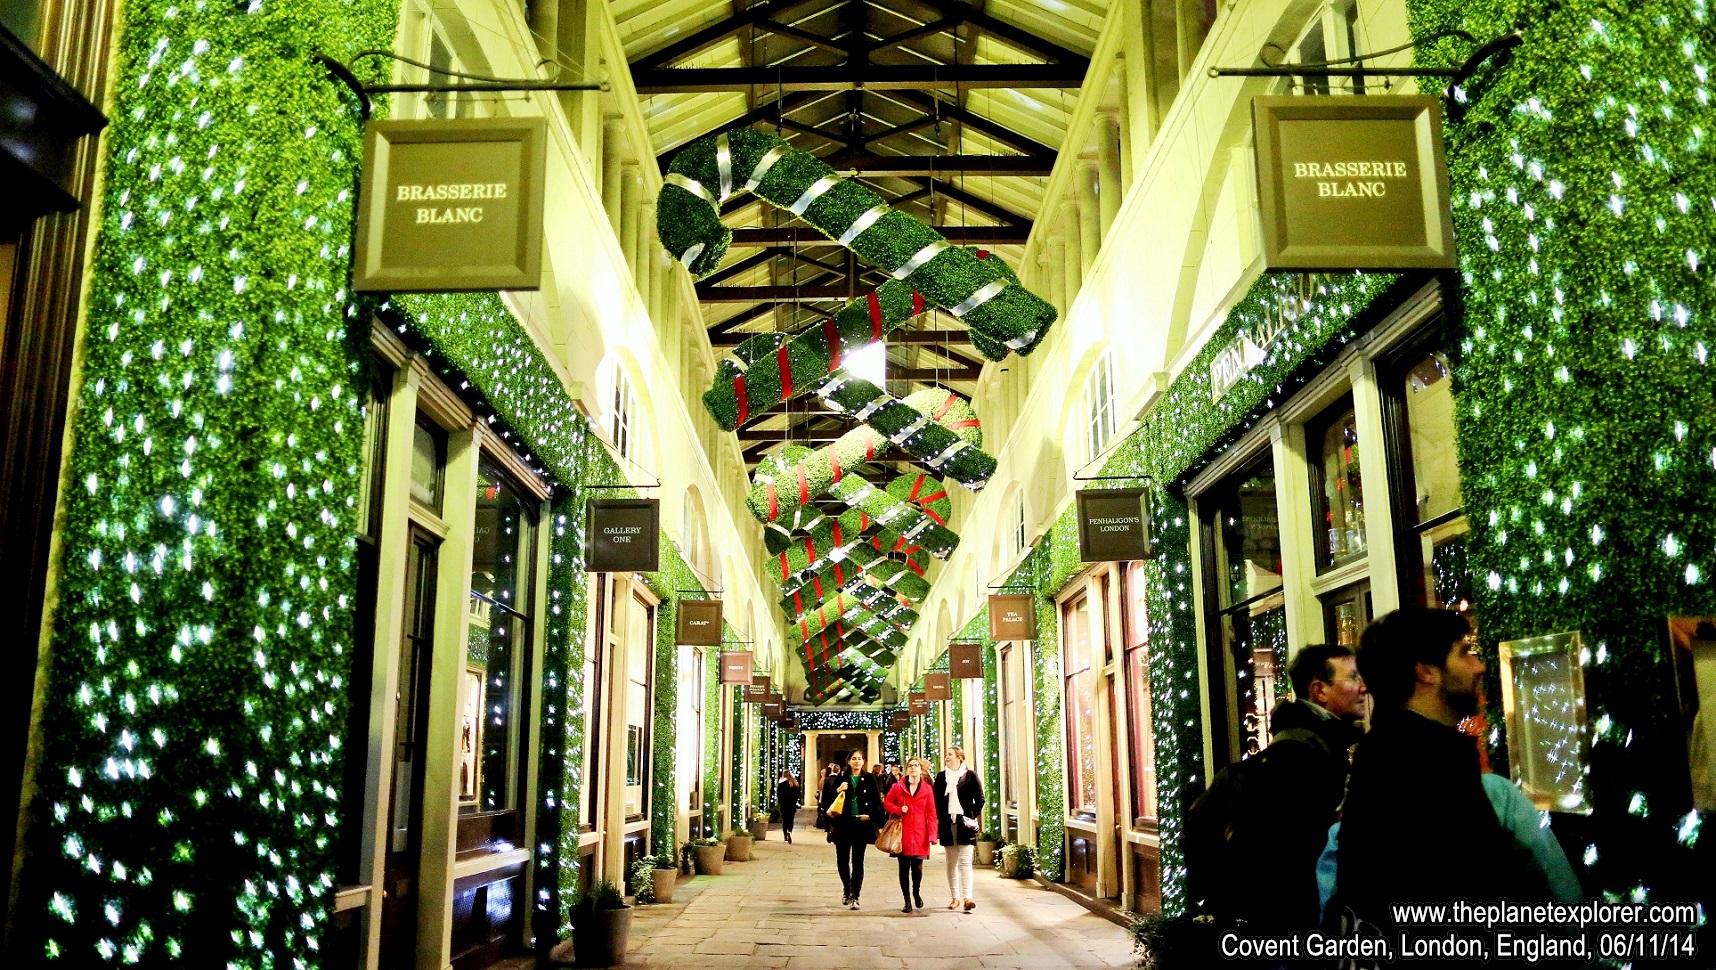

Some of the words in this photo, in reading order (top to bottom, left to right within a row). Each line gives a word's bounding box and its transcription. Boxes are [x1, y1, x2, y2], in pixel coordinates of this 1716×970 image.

[1294, 162, 1407, 178] BRASSERIE
[397, 183, 507, 200] BRASSERIE
[1318, 182, 1386, 197] BLANC
[416, 207, 483, 224] BLANC
[1089, 517, 1140, 525] PENHALIGON'S
[603, 527, 642, 535] GALLERY
[612, 535, 632, 543] ONE
